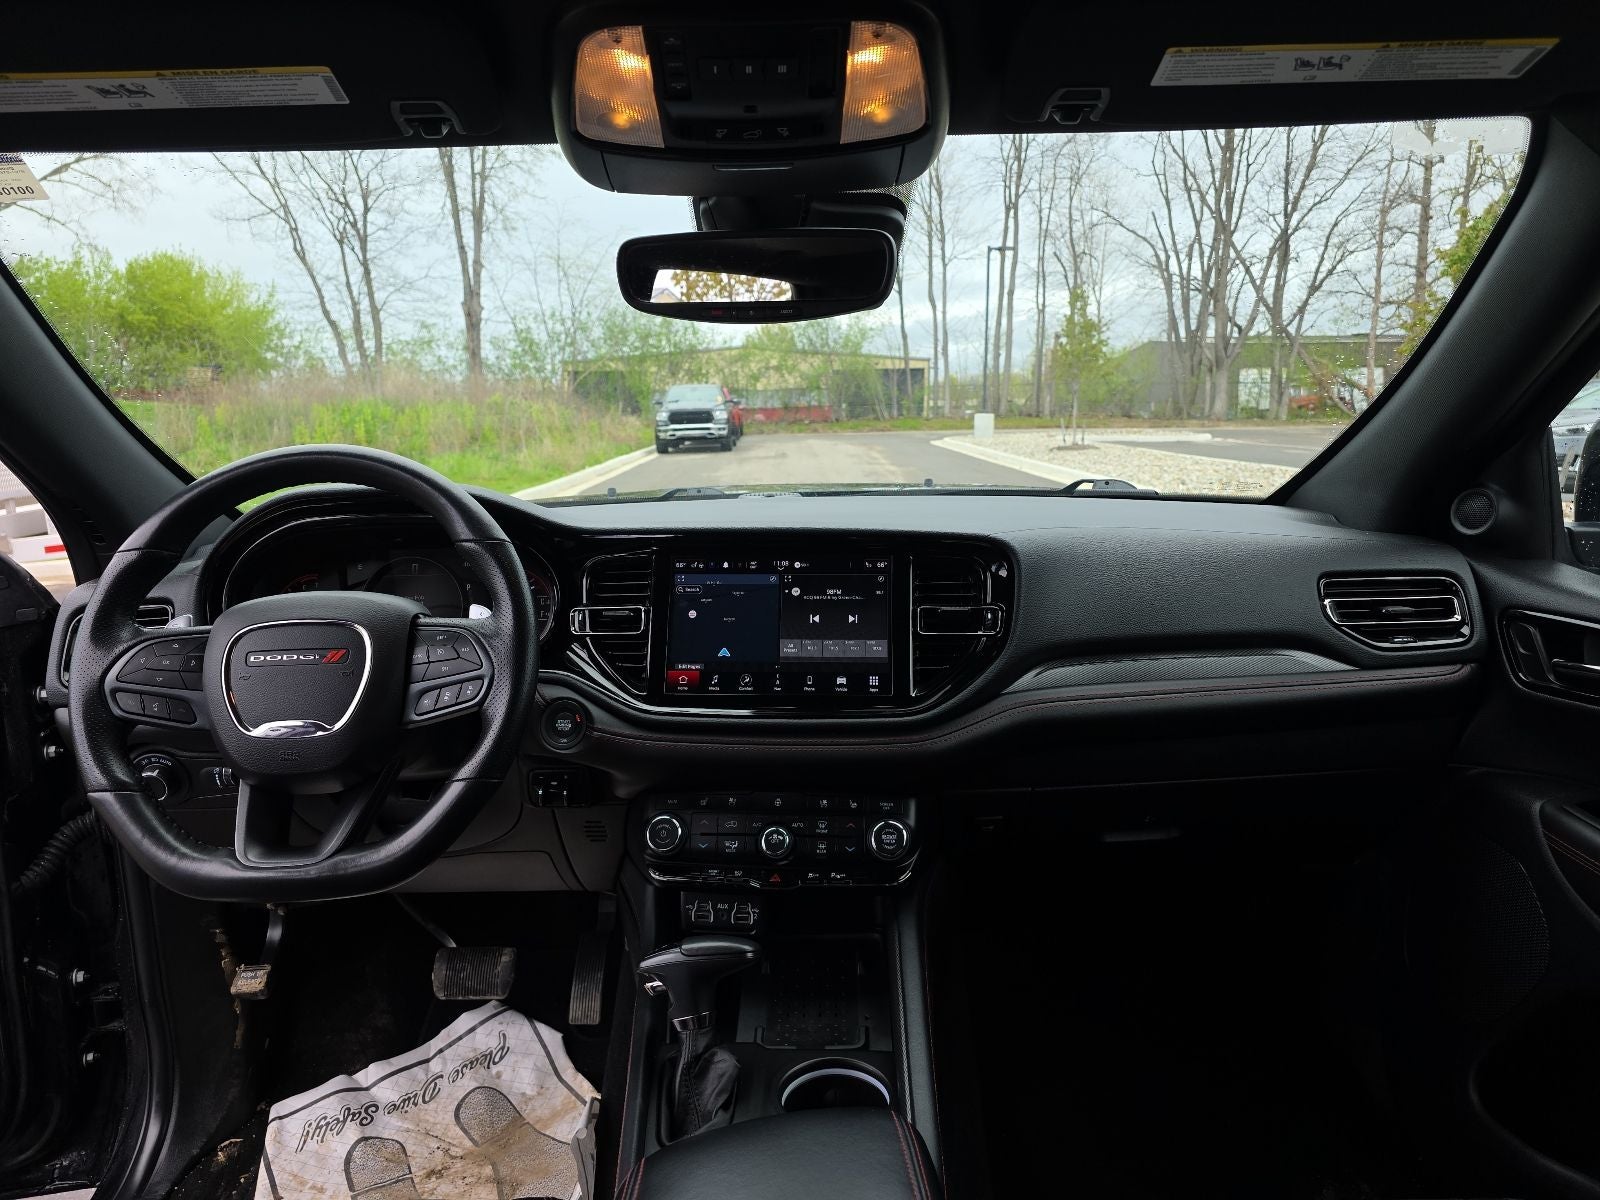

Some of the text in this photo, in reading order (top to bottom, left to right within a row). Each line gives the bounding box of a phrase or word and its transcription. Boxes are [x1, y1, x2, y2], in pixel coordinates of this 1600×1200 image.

[0, 186, 35, 196] 0100
[250, 654, 319, 662] DODGE
[296, 1030, 510, 1154] Please Drive Safely!
